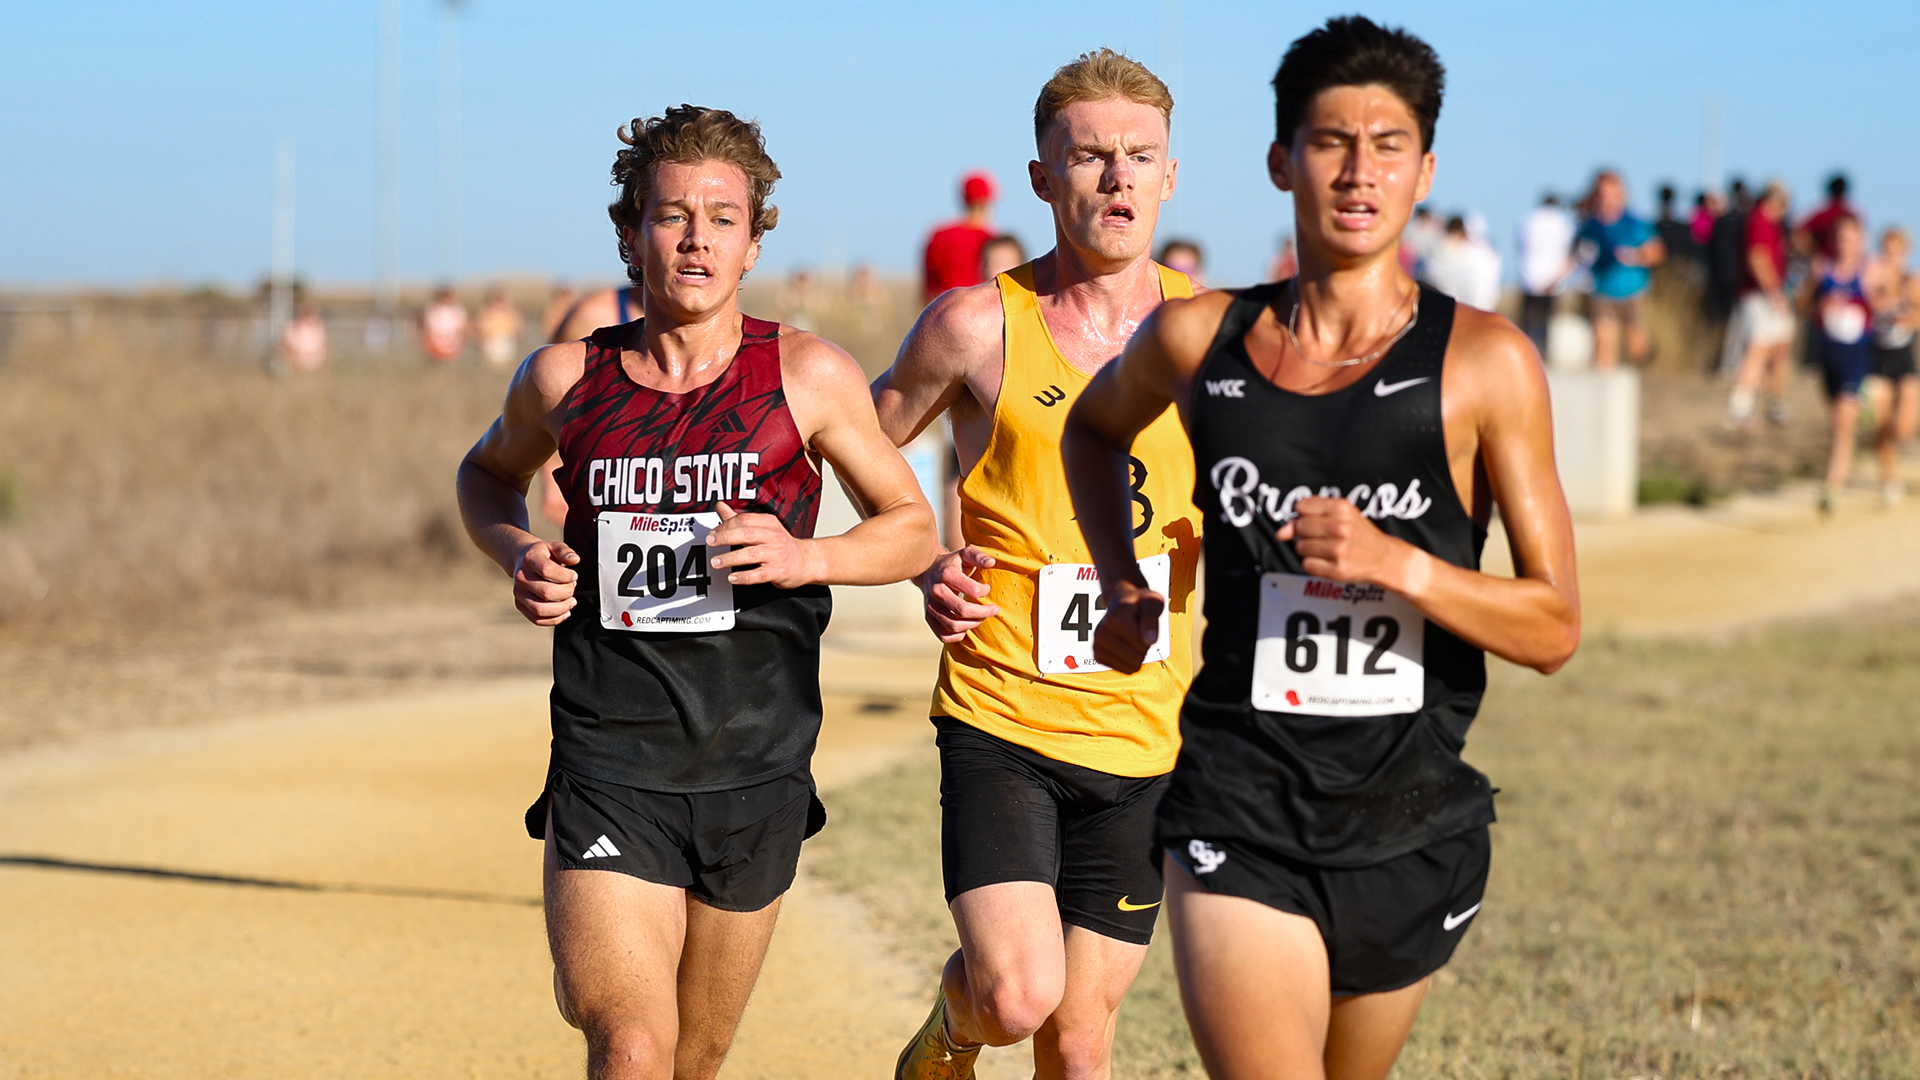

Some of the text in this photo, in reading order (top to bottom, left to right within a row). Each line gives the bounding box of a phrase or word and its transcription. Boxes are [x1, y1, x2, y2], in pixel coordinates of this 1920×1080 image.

[1205, 379, 1246, 398] WCC
[588, 452, 760, 506] CHICO STATE
[629, 516, 696, 536] MileSplit
[617, 543, 711, 599] 204
[636, 616, 711, 625] REDCAPTIMING.COM
[1285, 611, 1399, 675] 612
